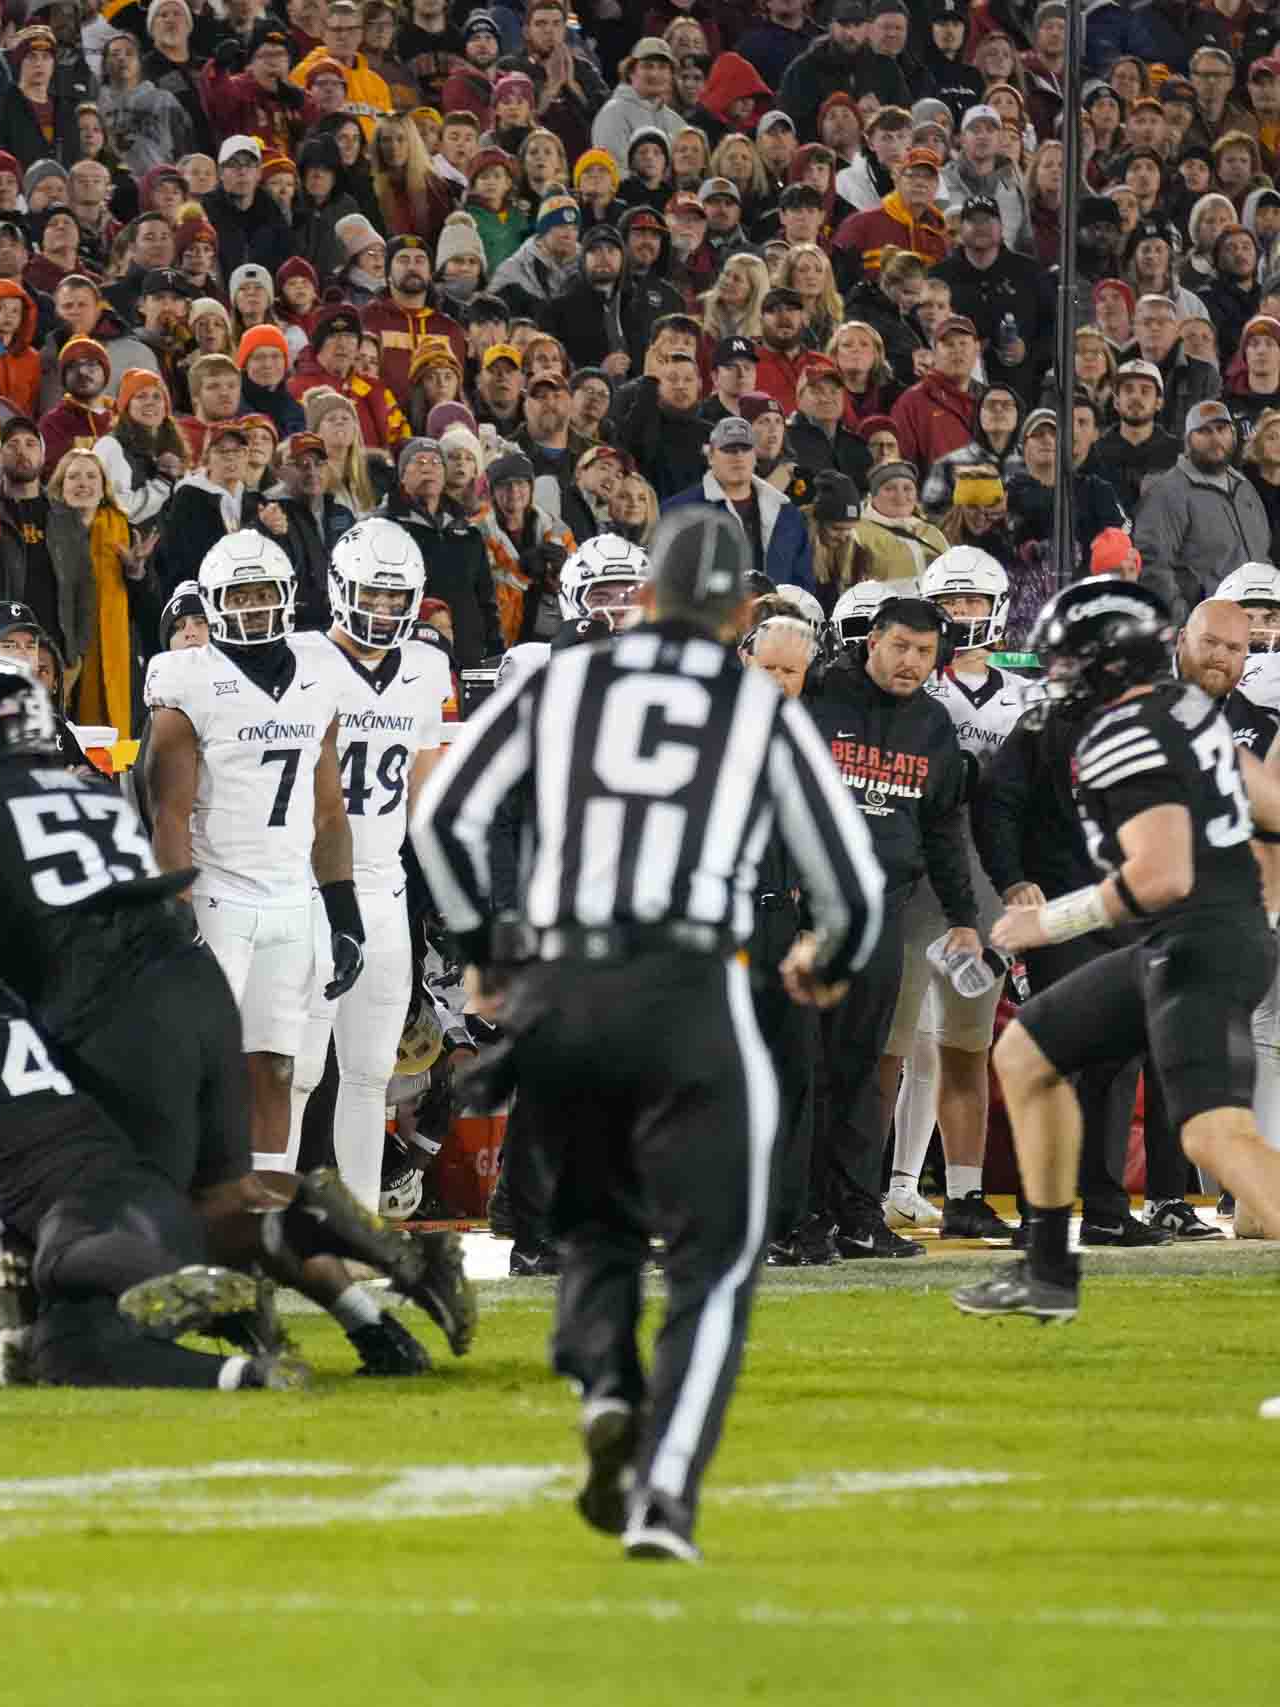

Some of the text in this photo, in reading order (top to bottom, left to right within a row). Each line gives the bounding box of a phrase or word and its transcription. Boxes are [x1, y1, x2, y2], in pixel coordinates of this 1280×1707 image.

[237, 720, 314, 743] CINCINNATI
[594, 672, 711, 797] C
[832, 739, 928, 777] BEARCATS
[261, 749, 302, 827] 7
[340, 741, 409, 816] 49
[8, 793, 162, 906] 53
[1, 1019, 74, 1096] 4
